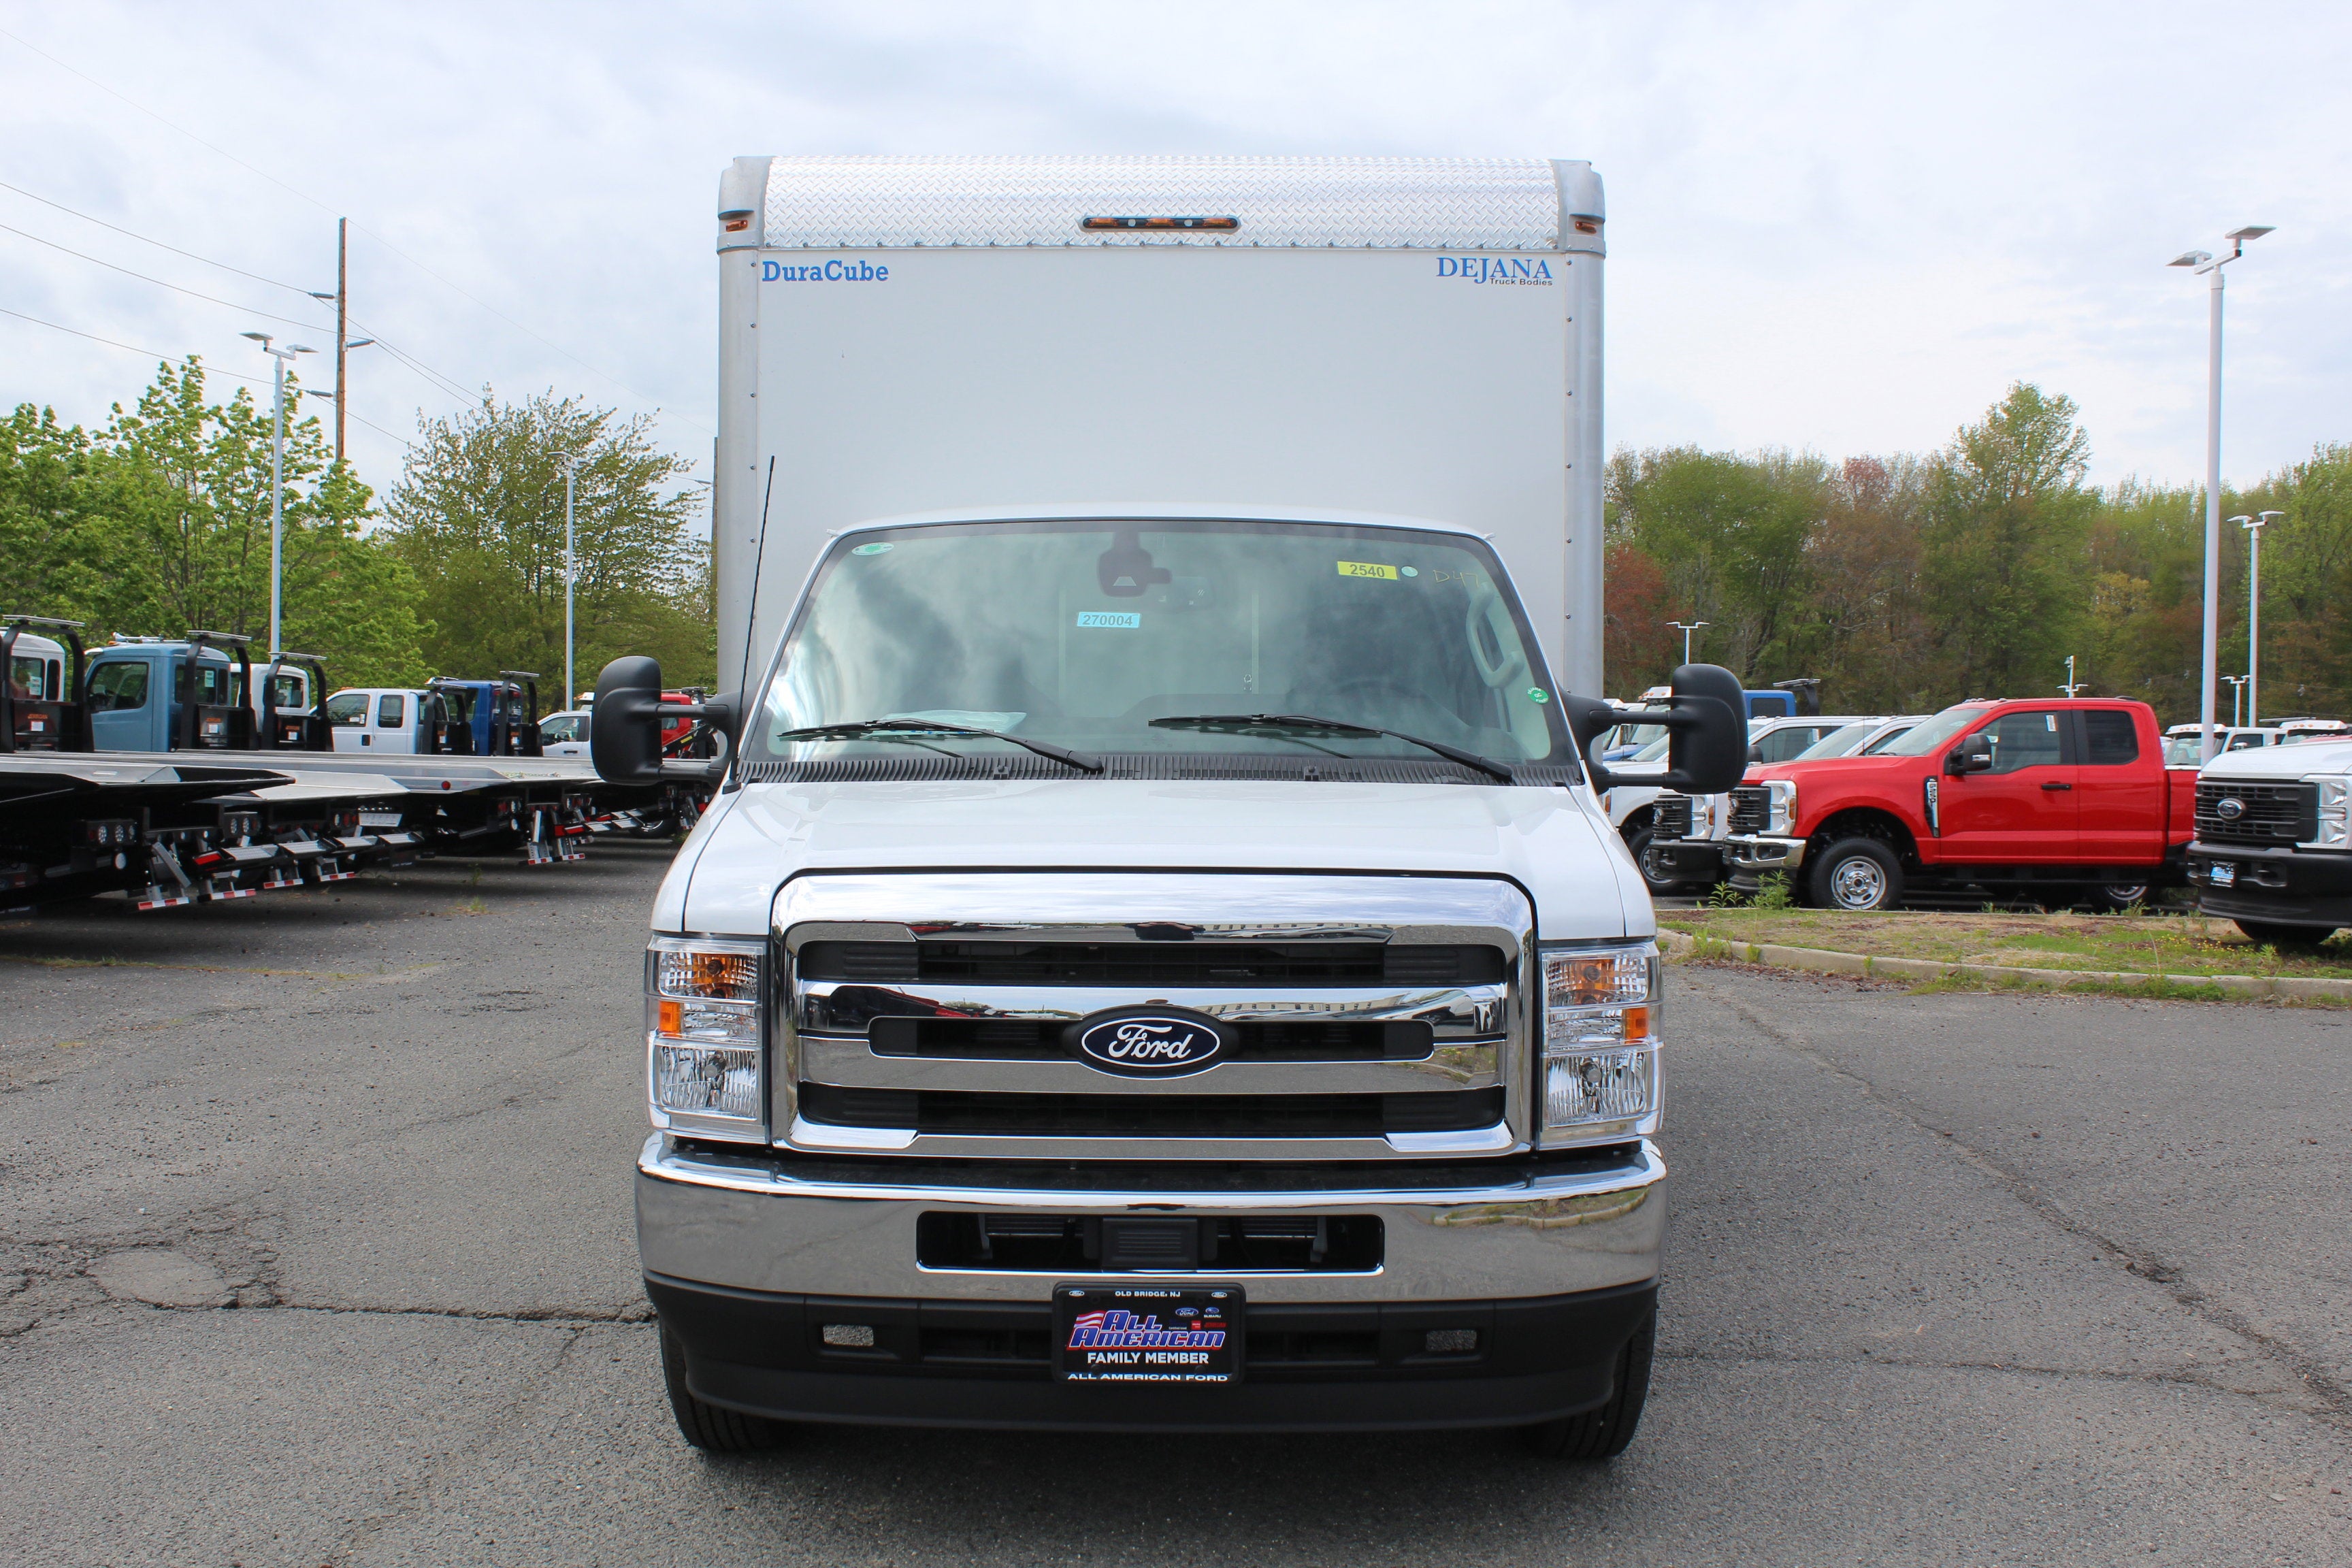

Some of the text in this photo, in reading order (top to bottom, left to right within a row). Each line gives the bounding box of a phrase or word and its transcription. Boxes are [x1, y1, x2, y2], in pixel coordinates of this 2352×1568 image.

[762, 260, 889, 282] DuraCube
[1436, 257, 1553, 284] DEJANA
[1350, 564, 1385, 577] 2540
[1433, 570, 1480, 588] D47
[1082, 615, 1132, 626] 270004
[1108, 1024, 1193, 1058] Ford
[1088, 1352, 1209, 1364] FAMILY MEMBER
